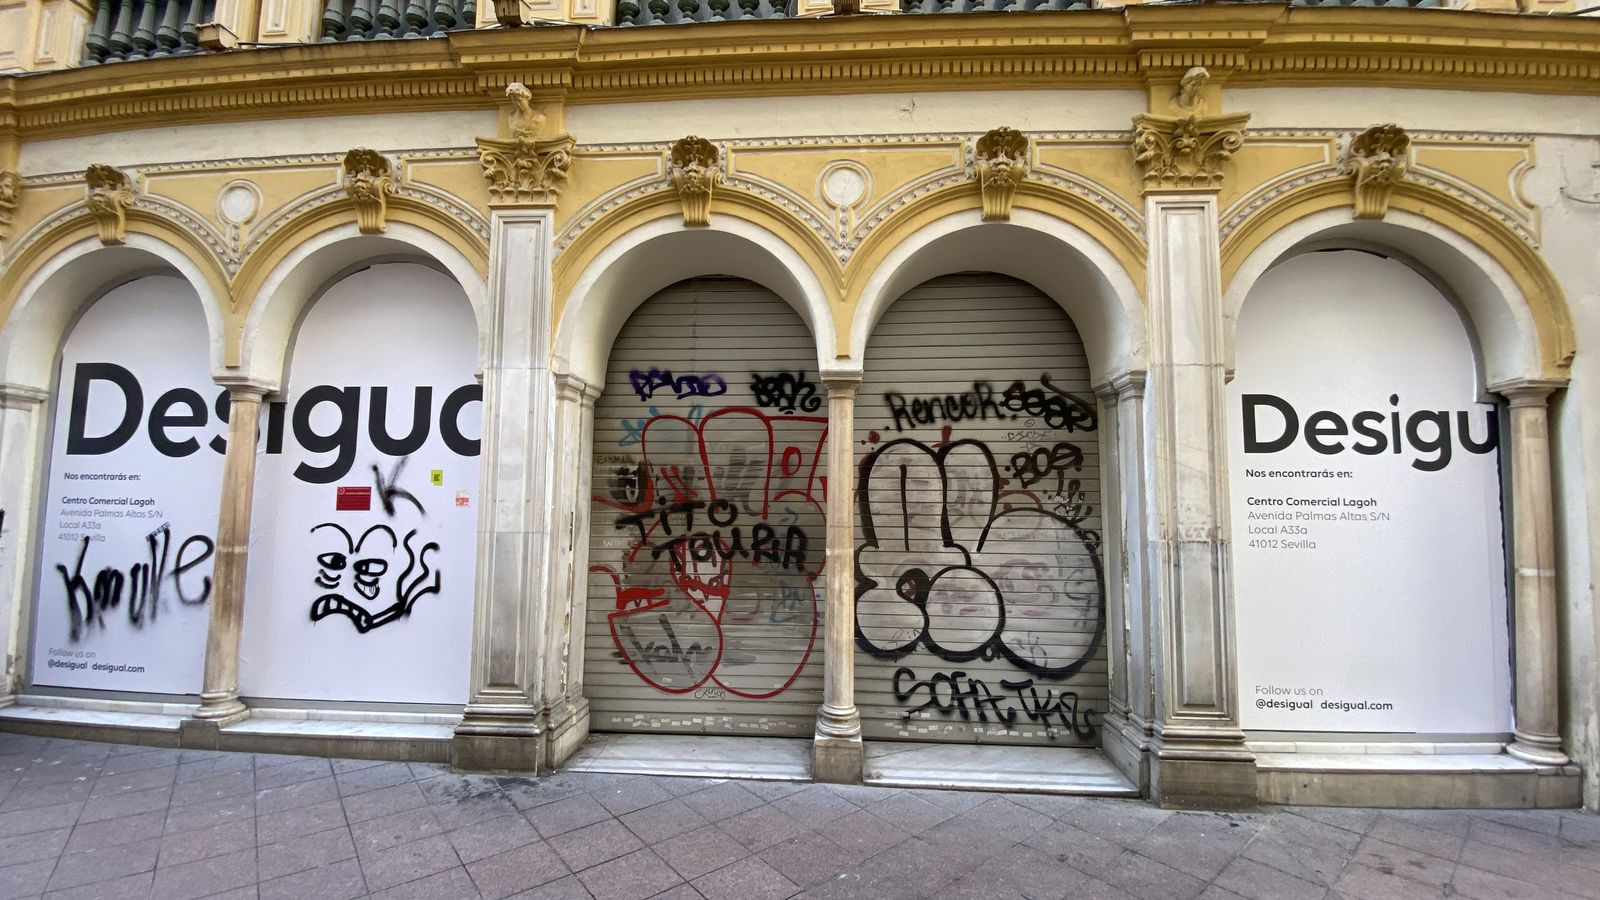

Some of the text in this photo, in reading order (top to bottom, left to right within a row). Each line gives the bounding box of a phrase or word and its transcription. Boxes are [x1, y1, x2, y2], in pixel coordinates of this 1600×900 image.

[64, 472, 79, 480] Nos
[80, 472, 127, 481] encontrarás
[1245, 468, 1353, 478] Nos encontrarás en:
[62, 496, 155, 507] Centro Comercial Lagoh
[1247, 497, 1377, 508] Centro Comercial Lagoh
[60, 508, 164, 518] Avenida Palmas Altas S/N
[1248, 512, 1390, 521] Avenida Palmas Altas S/N
[59, 521, 102, 530] Local A33a
[1248, 526, 1308, 534] Local A33a
[58, 533, 106, 542] 41012 Svilla
[1248, 540, 1316, 549] 41012 Sevilla
[48, 648, 74, 658] Follow
[48, 659, 144, 673] @desigual desigual.com
[1255, 686, 1324, 696] Follow us on
[1256, 698, 1393, 712] @desigual desigual.com
